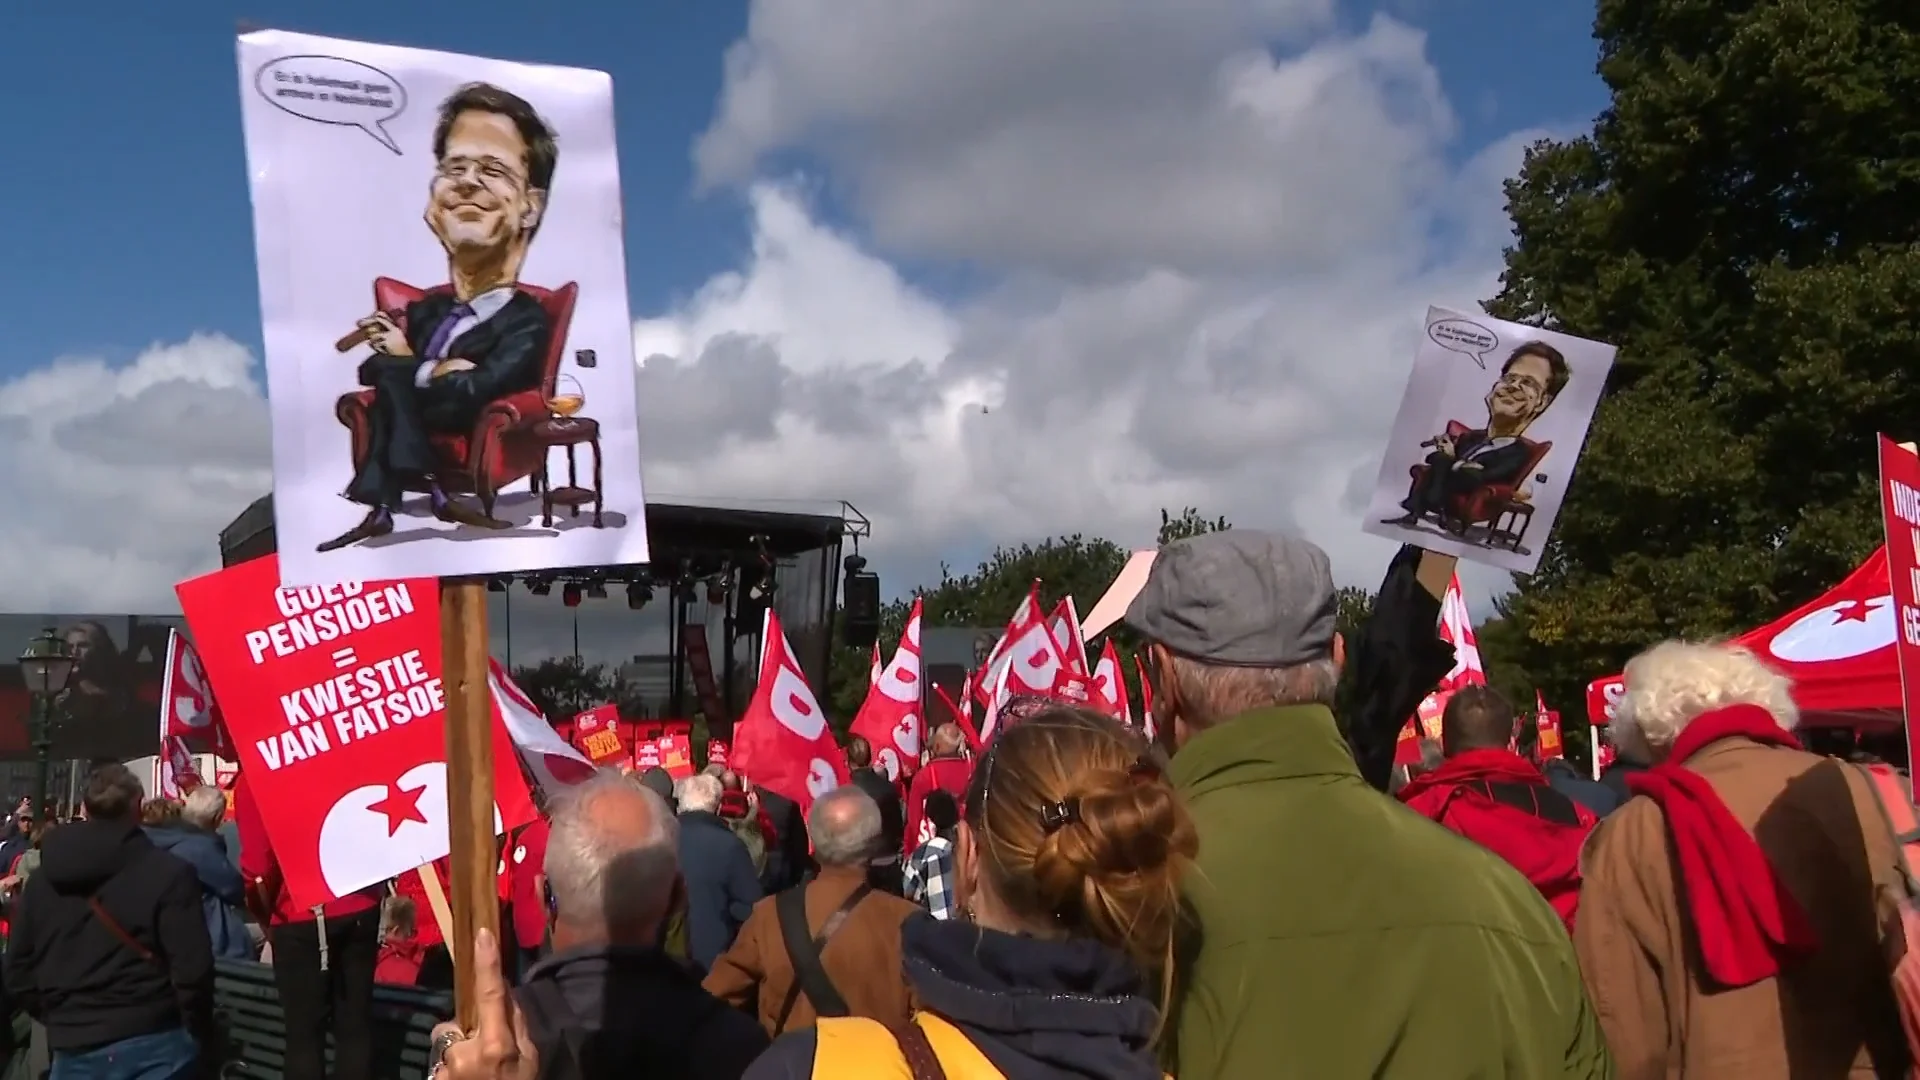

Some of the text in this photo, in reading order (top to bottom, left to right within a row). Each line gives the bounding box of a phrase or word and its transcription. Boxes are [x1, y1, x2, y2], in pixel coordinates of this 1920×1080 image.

[1889, 479, 1920, 526] INDE
[245, 582, 415, 665] PENSIOEN
[256, 677, 446, 771] VAN FATSOE
[280, 649, 429, 726] KWESTIE
